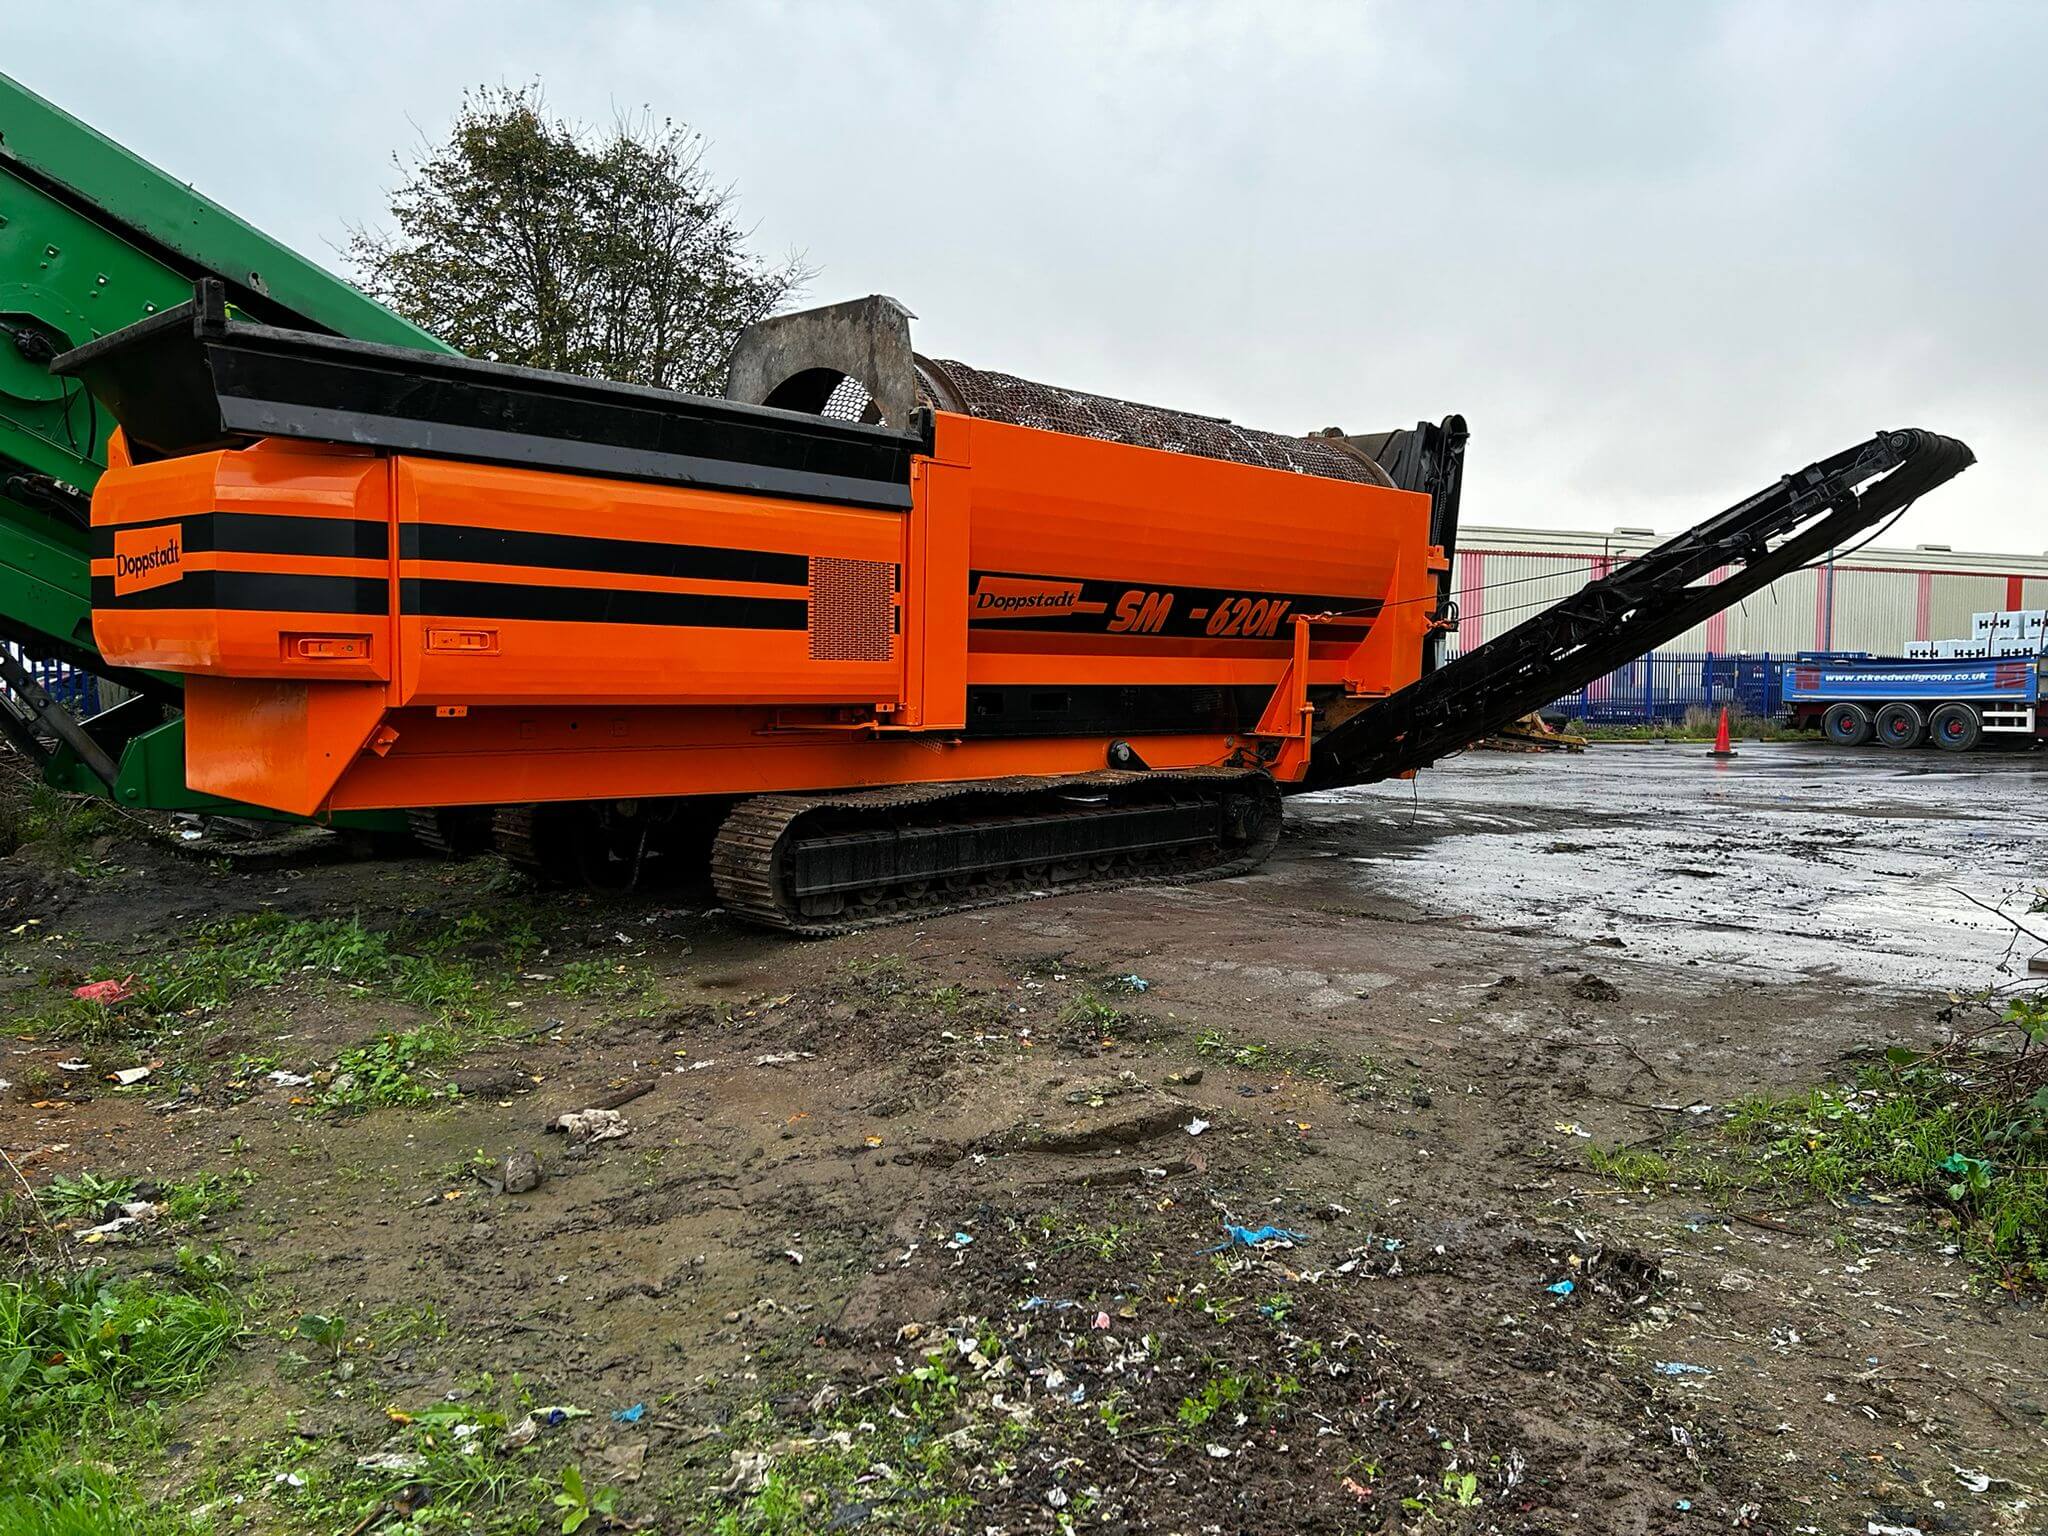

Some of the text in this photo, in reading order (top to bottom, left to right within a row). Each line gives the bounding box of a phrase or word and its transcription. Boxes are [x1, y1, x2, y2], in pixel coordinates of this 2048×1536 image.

[116, 538, 180, 578] Doppstadt
[976, 590, 1076, 611] Doppstadt
[1106, 590, 1174, 633] SM
[1954, 647, 1986, 658] H+H
[2001, 647, 2033, 657] H+H
